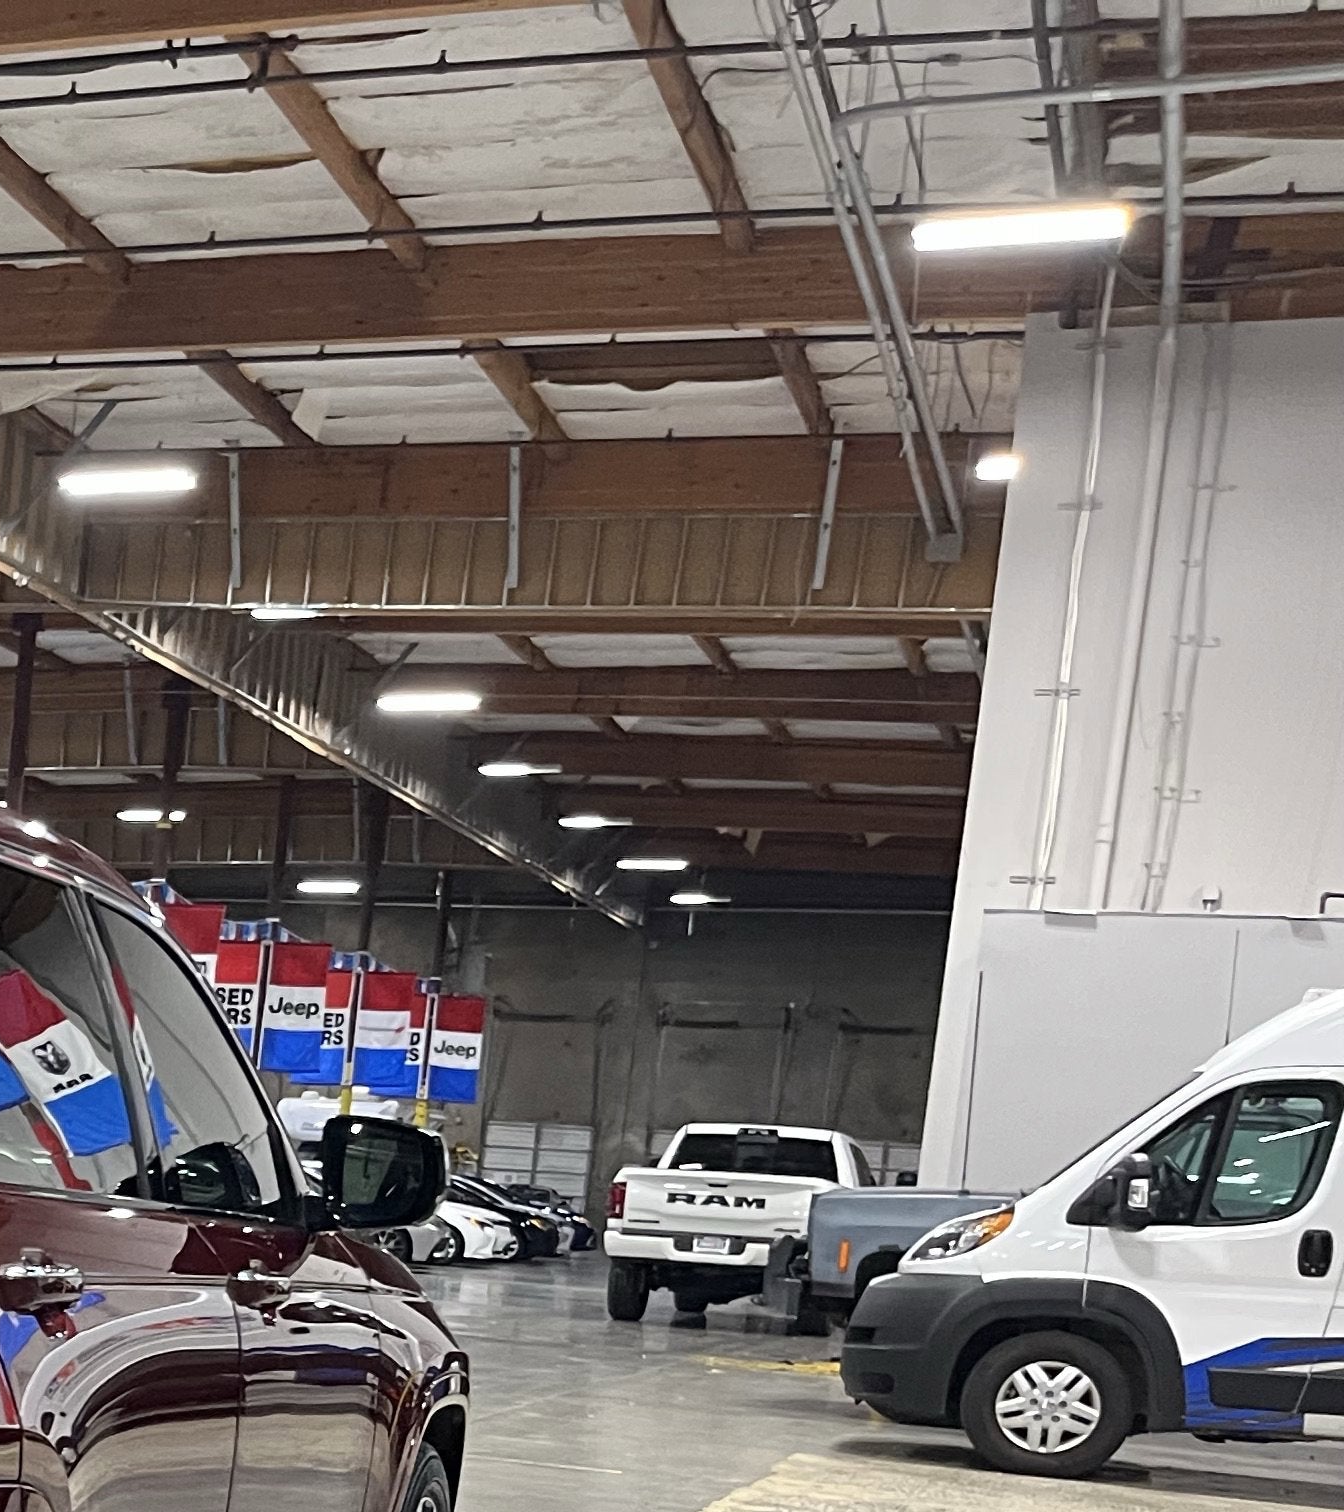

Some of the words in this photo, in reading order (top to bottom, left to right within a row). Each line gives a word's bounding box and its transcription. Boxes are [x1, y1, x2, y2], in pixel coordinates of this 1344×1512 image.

[214, 987, 254, 1006] SED
[226, 1008, 252, 1025] RS
[268, 997, 320, 1019] Jeep
[323, 1013, 345, 1028] ED
[320, 1030, 344, 1046] RS
[433, 1040, 477, 1059] Jeep
[666, 1192, 767, 1210] RAM
